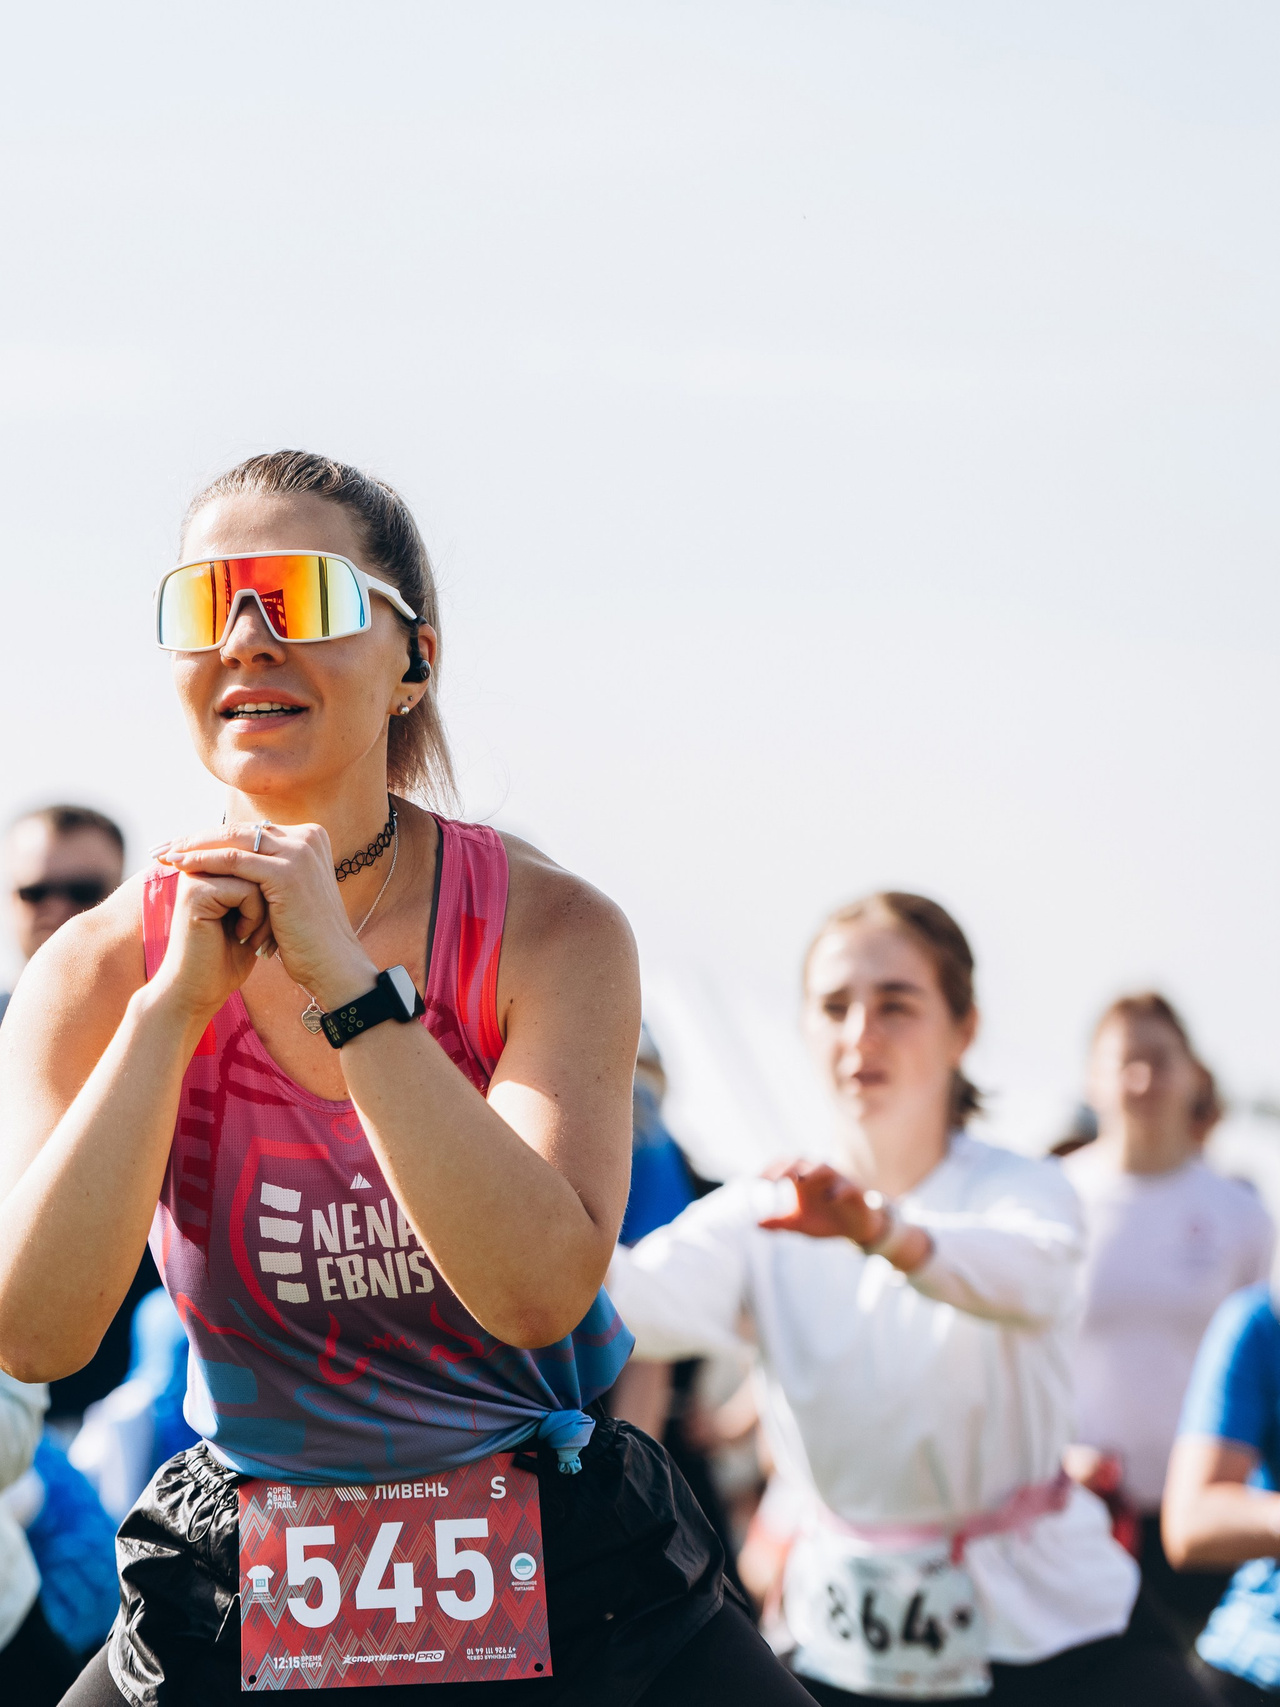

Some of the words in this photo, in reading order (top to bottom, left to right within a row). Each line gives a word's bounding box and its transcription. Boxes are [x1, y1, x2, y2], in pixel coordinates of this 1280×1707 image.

[317, 1251, 435, 1301] EBNIS
[272, 1486, 291, 1494] OPEN
[374, 1482, 449, 1500] ЛИВЕНЬ
[490, 1476, 507, 1499] S
[272, 1493, 292, 1501] BAND
[273, 1501, 297, 1509] TRAILS
[285, 1518, 495, 1628] 545
[273, 1655, 300, 1669] 12:15
[417, 1652, 444, 1661] PRO
